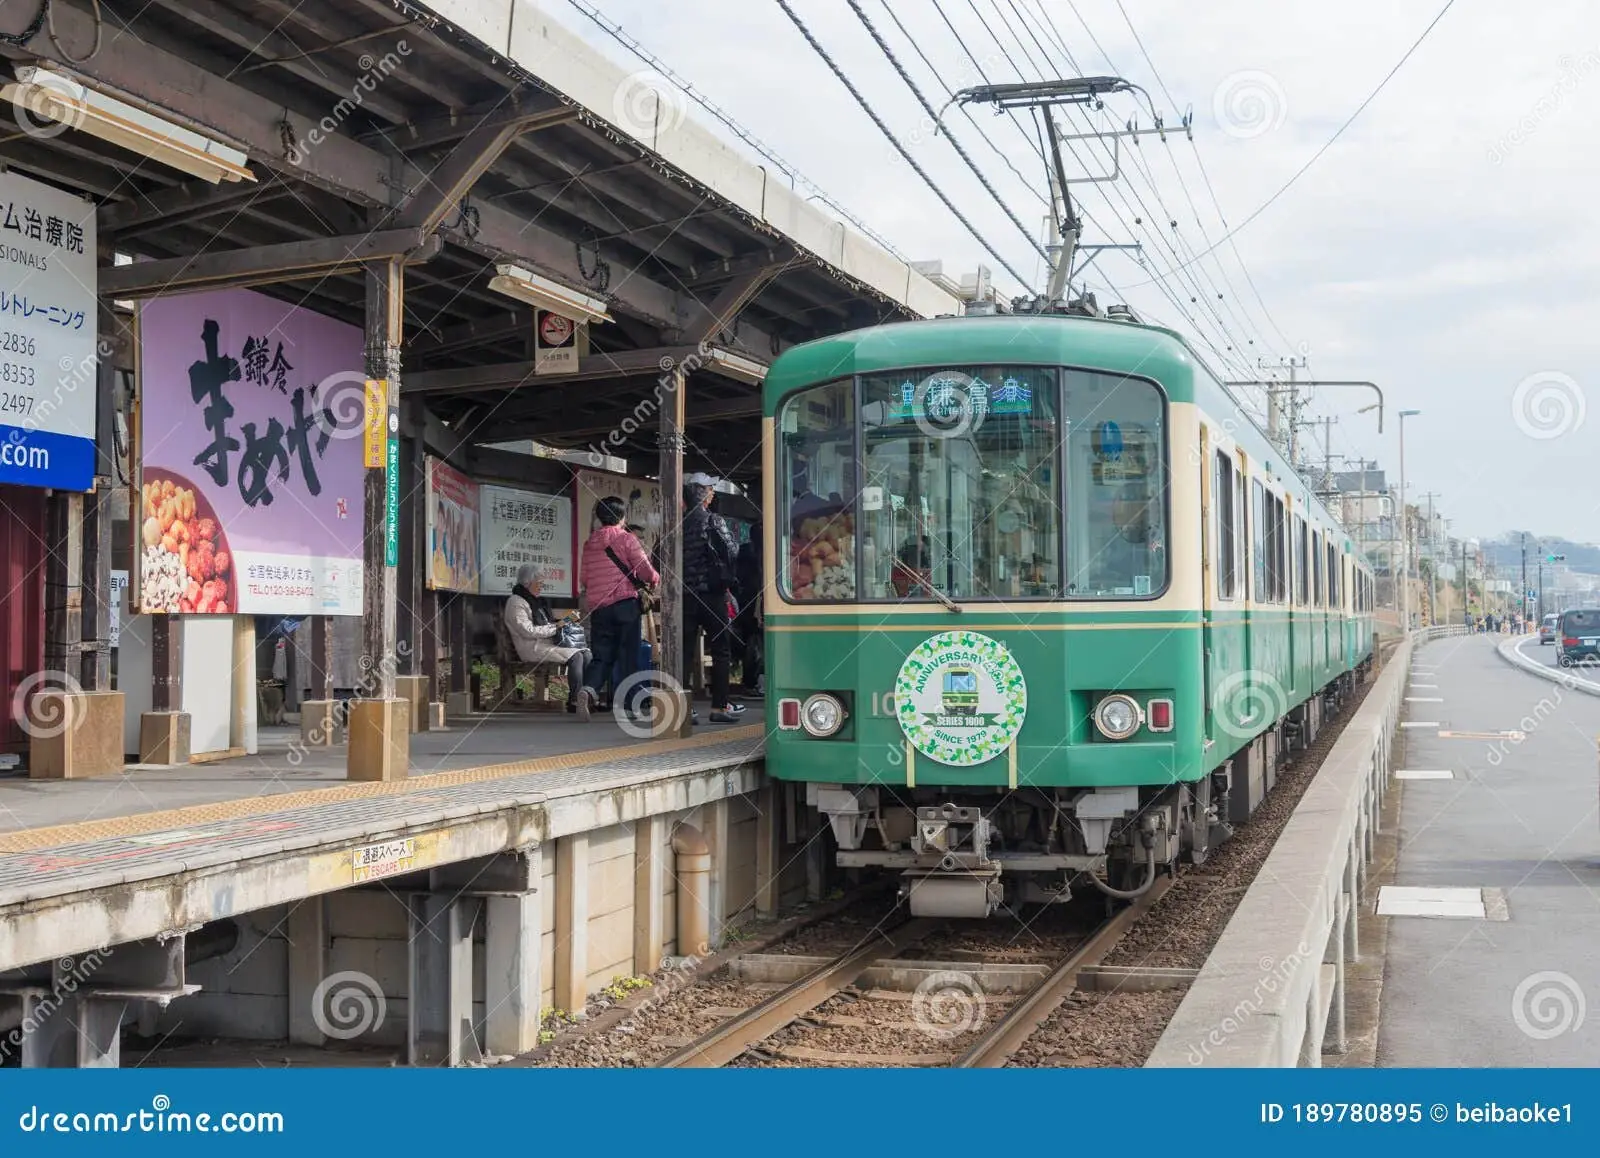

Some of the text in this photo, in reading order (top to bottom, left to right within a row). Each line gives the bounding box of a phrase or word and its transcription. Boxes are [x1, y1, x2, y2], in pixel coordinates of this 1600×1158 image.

[0, 203, 84, 254] ム治療院
[242, 336, 294, 395] 鎌倉
[927, 376, 992, 406] 鎌倉
[936, 716, 964, 726] SERIES
[935, 730, 987, 744] SINCE 1979
[363, 842, 406, 864] 退避スペース
[371, 860, 398, 877] ESCAPE
